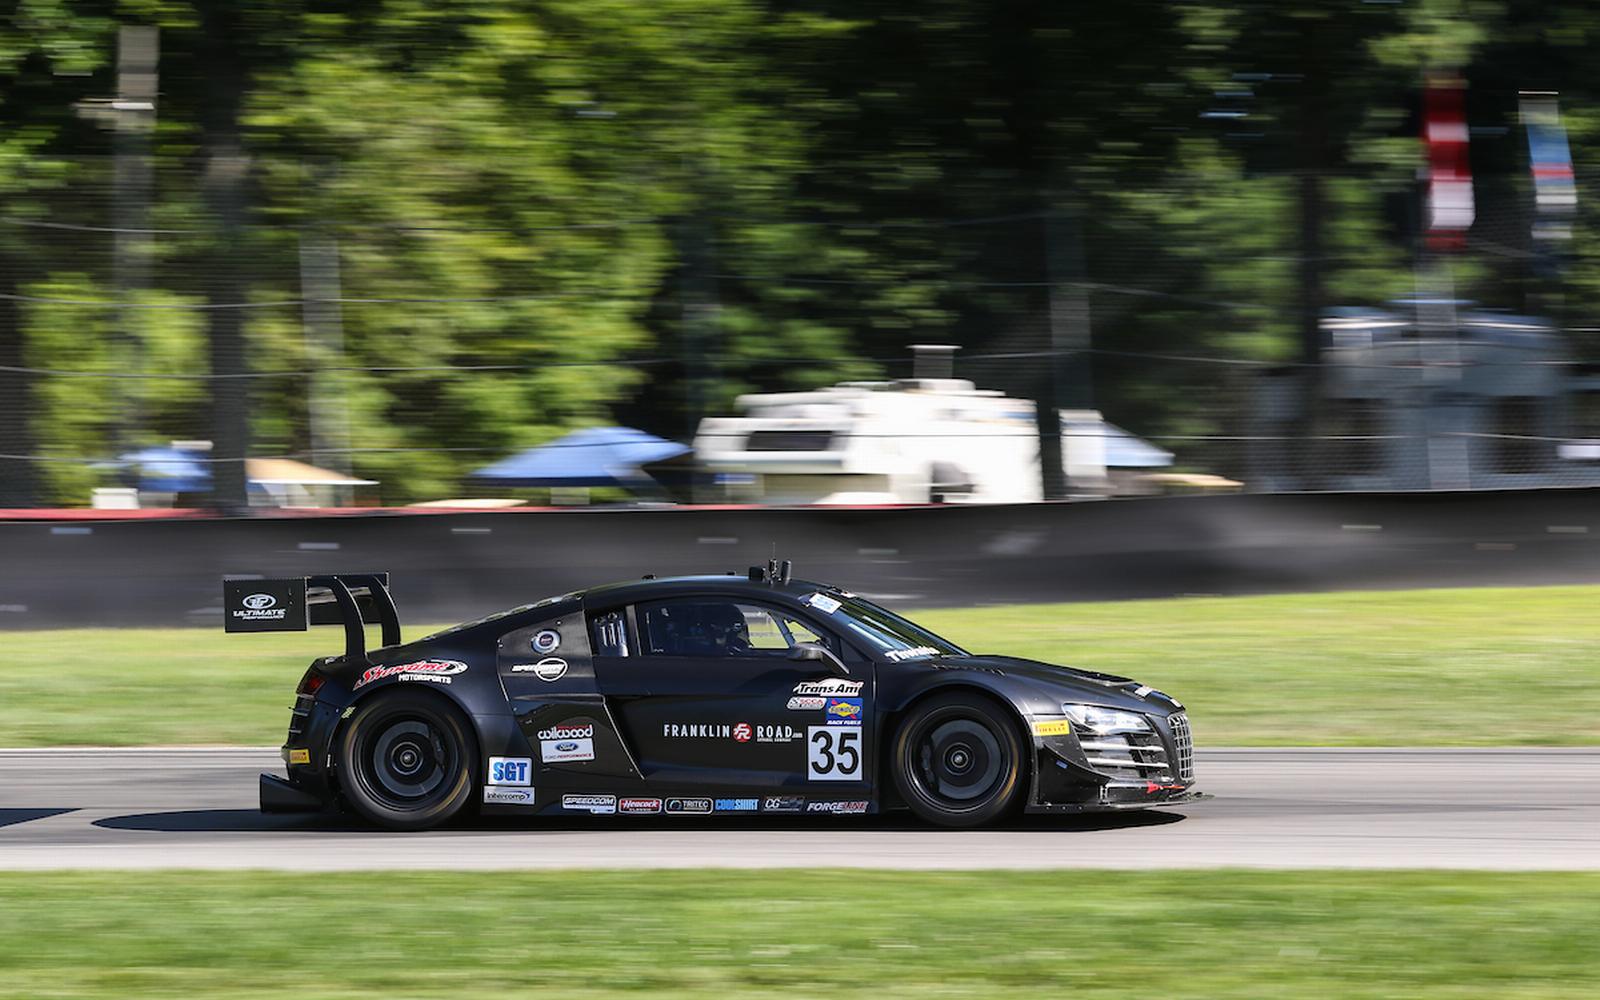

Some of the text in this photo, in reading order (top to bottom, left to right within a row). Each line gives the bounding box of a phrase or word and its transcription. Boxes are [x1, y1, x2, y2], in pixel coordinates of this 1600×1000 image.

[233, 608, 286, 617] ULTIMATE
[398, 673, 452, 684] MOTORSPORTS
[799, 683, 859, 694] Trans Am
[537, 724, 593, 740] wilwood
[663, 724, 730, 738] FRANKLIN
[811, 730, 859, 774] 35
[493, 761, 528, 782] SGT
[486, 792, 526, 802] Intercomp
[564, 797, 614, 805] SPEEDCOM
